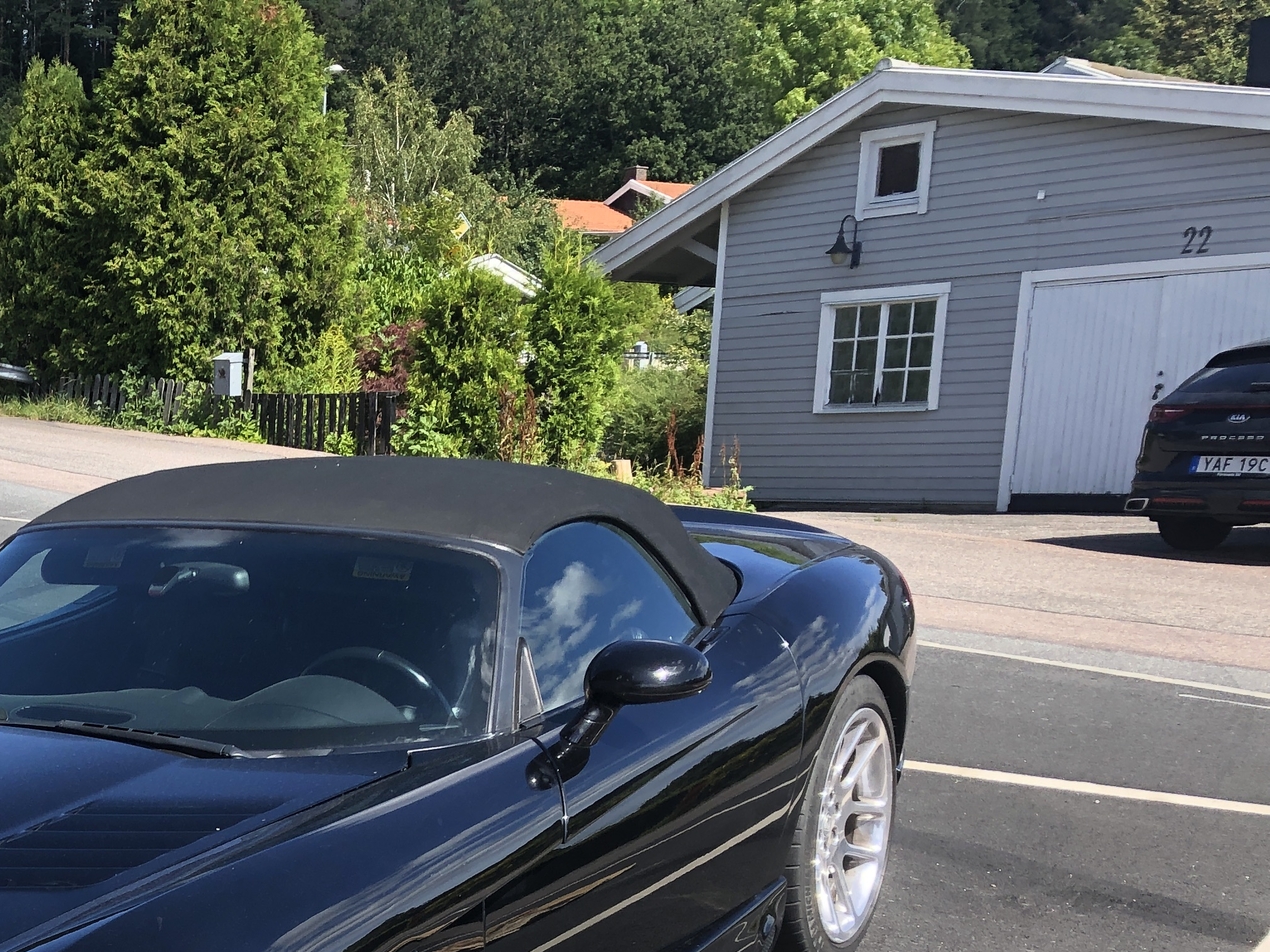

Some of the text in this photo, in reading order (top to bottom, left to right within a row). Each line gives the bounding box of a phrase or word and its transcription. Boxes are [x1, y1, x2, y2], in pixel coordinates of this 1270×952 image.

[1180, 226, 1213, 254] 22
[1204, 457, 1269, 472] YAF 19C
